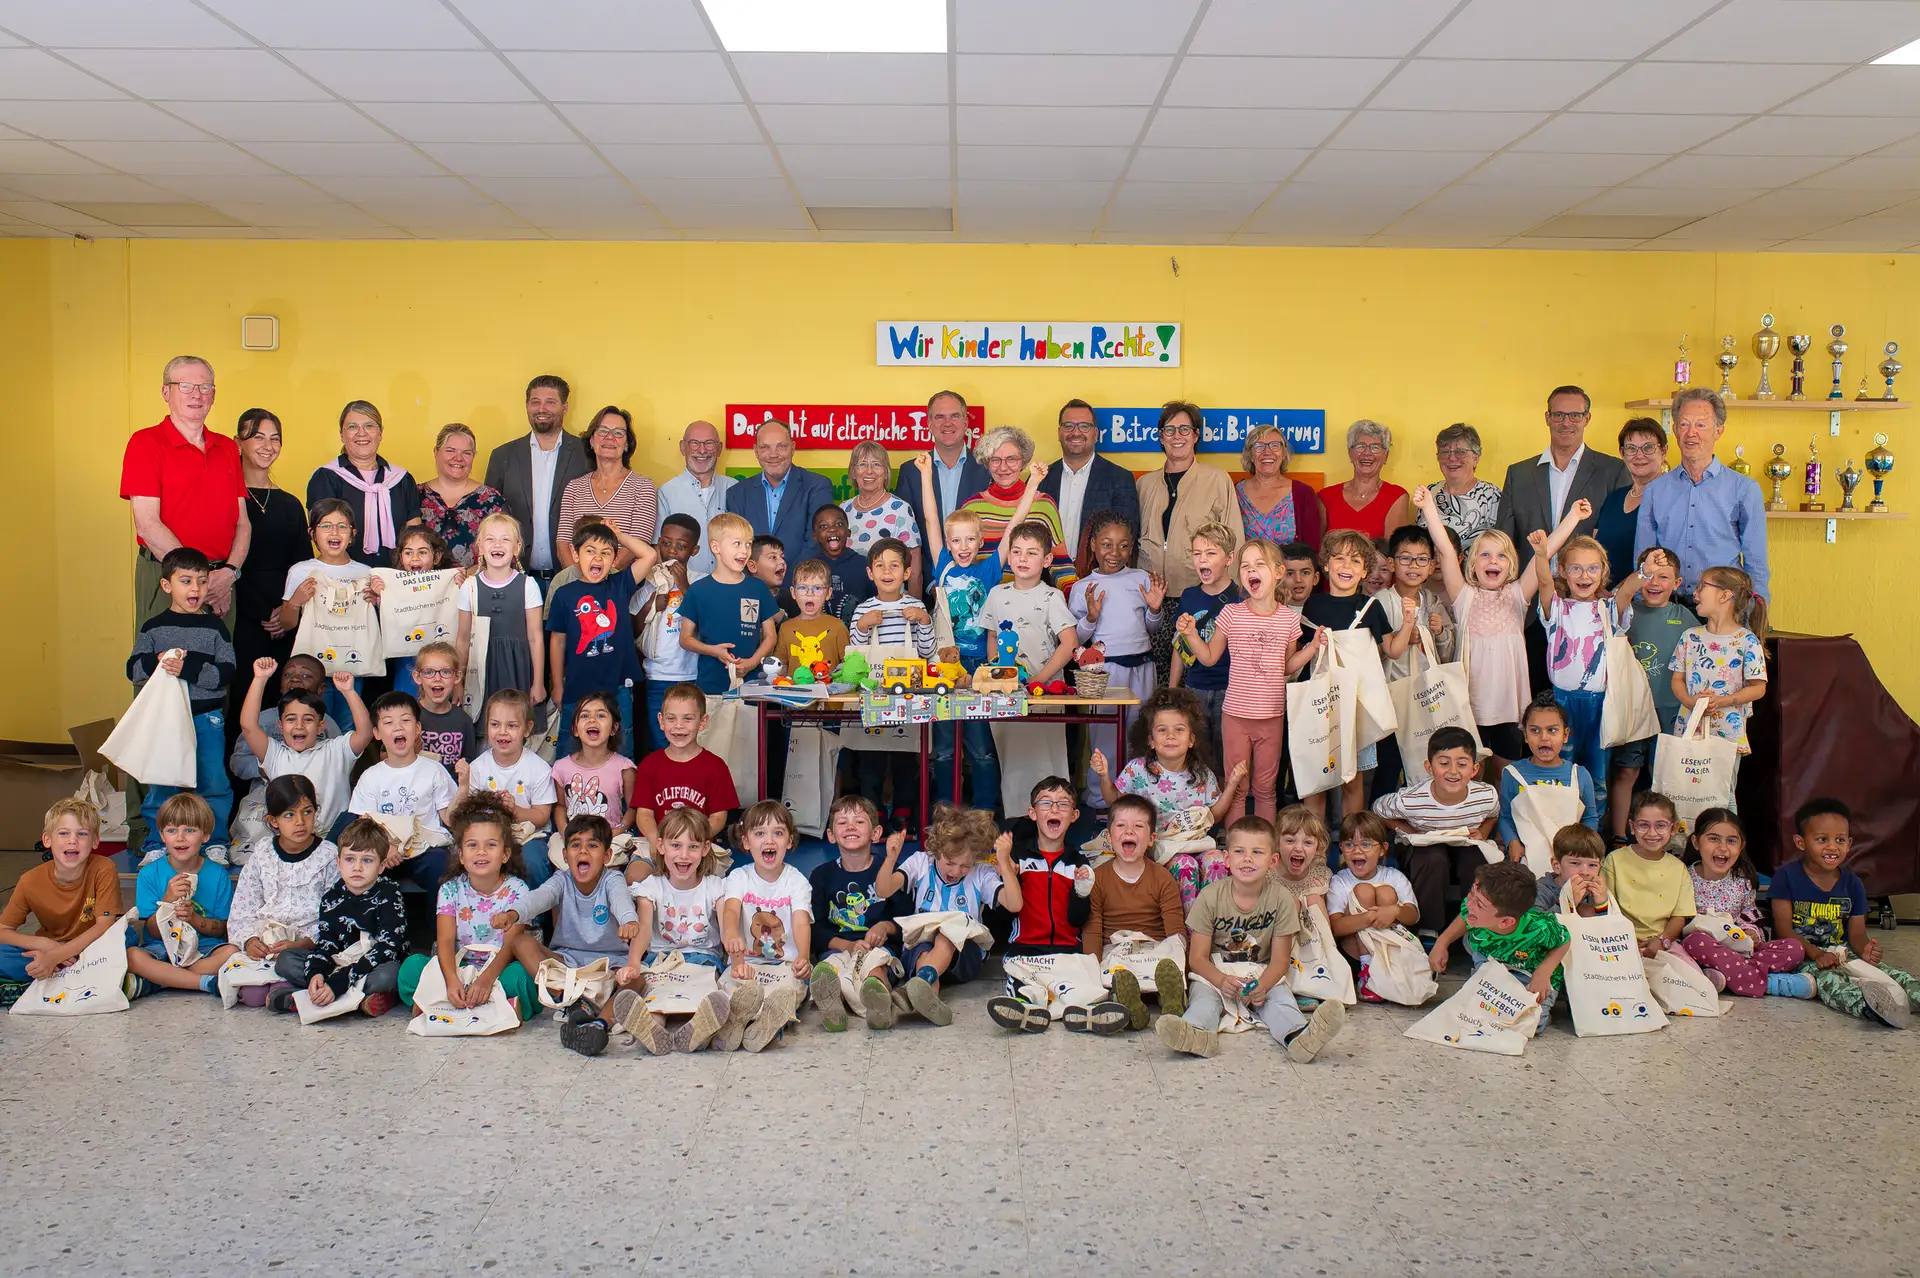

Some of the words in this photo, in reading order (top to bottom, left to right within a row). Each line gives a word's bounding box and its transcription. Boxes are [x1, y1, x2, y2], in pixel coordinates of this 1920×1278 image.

[889, 326, 934, 360] Wir
[941, 325, 1012, 360] Kinder
[1020, 325, 1084, 360] haben
[1090, 325, 1176, 362] Rechte!
[811, 412, 835, 440] auf
[836, 409, 908, 442] elterliche
[1202, 416, 1224, 442] bei
[402, 578, 417, 586] DAS
[418, 574, 440, 584] LEBEN
[412, 583, 432, 593] BUNT
[1684, 767, 1700, 775] DAS
[1600, 933, 1630, 944] MACHT
[1602, 943, 1629, 953] LEBEN
[1026, 957, 1056, 965] MACHT
[1478, 978, 1501, 995] LESEN
[1499, 990, 1527, 1010] MACHT
[1476, 989, 1493, 1001] DAS
[1490, 999, 1517, 1017] LEBEN
[1479, 1001, 1502, 1017] BUNT
